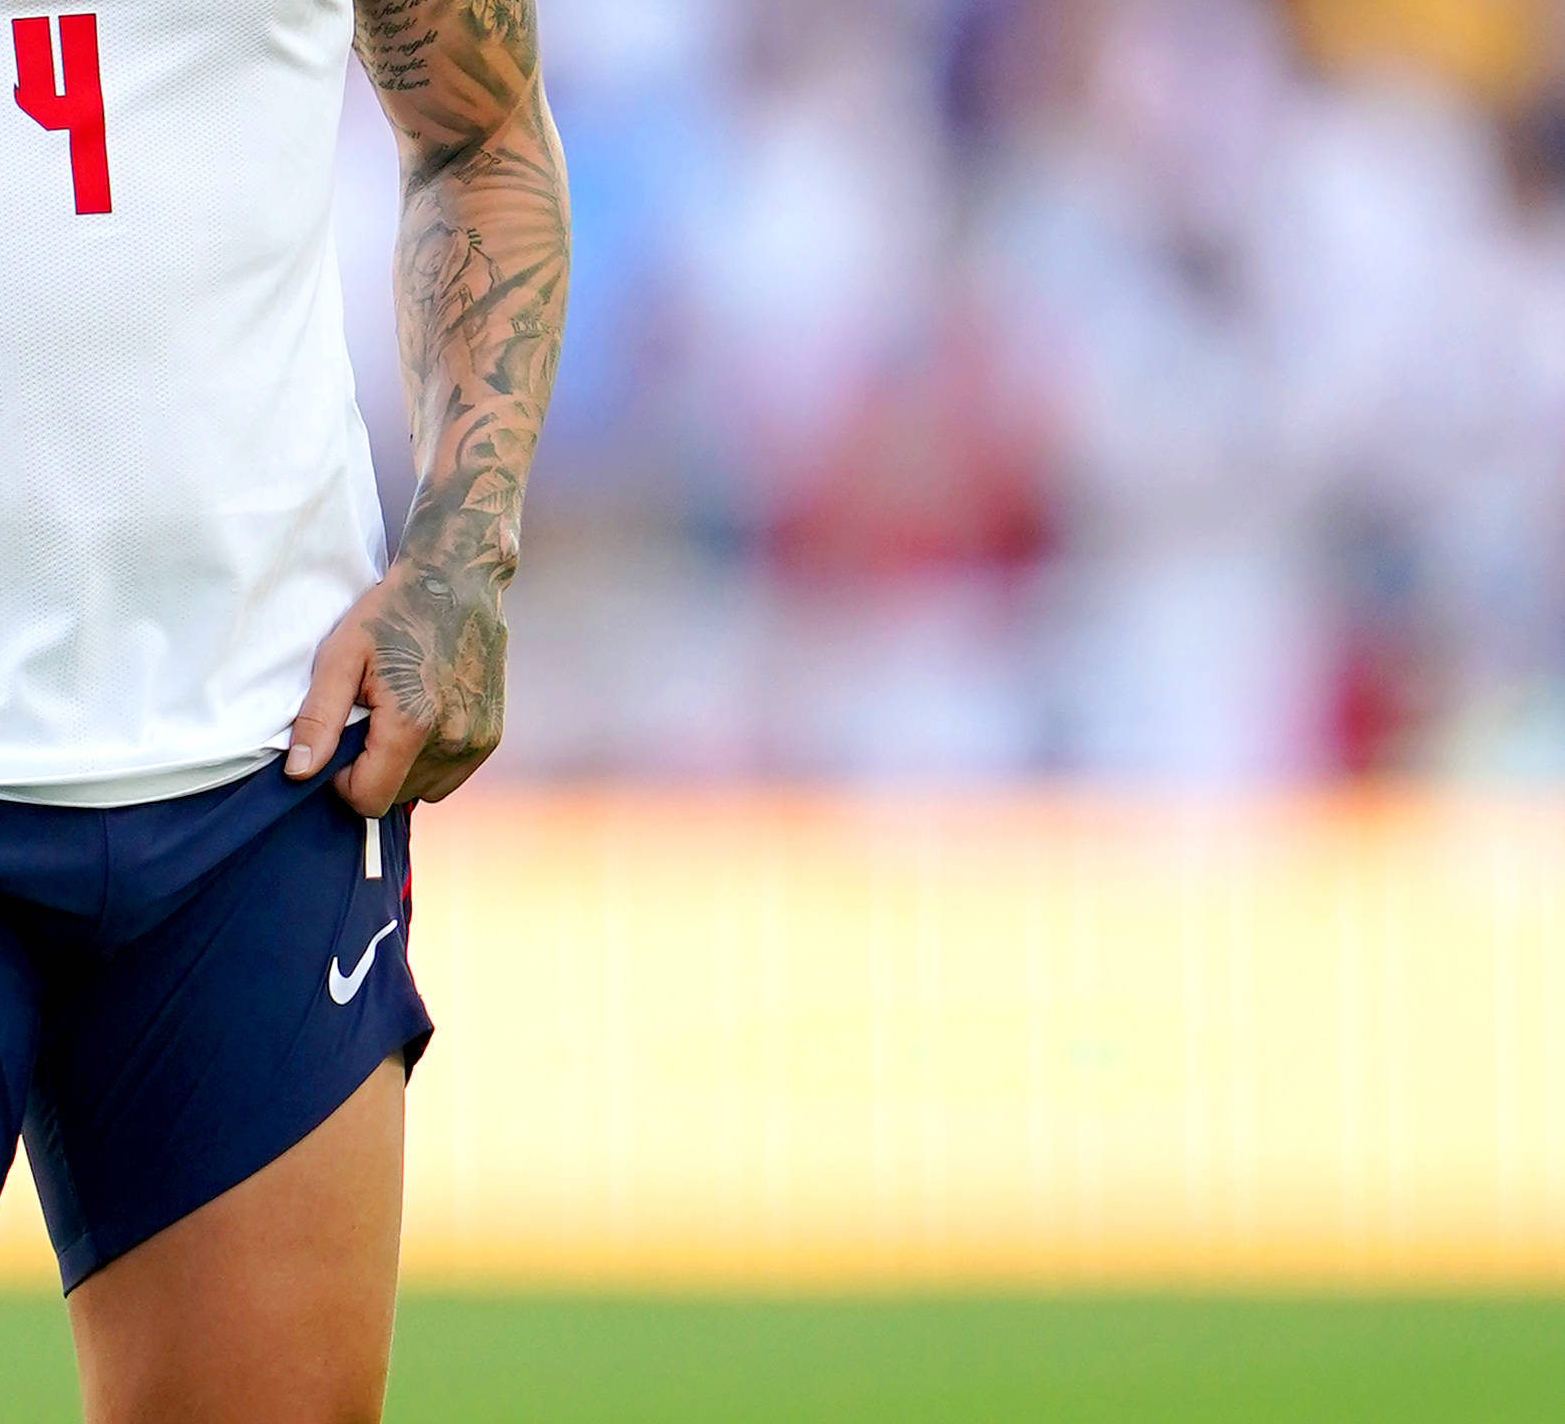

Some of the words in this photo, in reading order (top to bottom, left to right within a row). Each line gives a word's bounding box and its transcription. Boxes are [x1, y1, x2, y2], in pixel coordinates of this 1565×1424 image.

[397, 29, 438, 57] night
[397, 78, 430, 90] burn
[12, 13, 112, 215] 4
